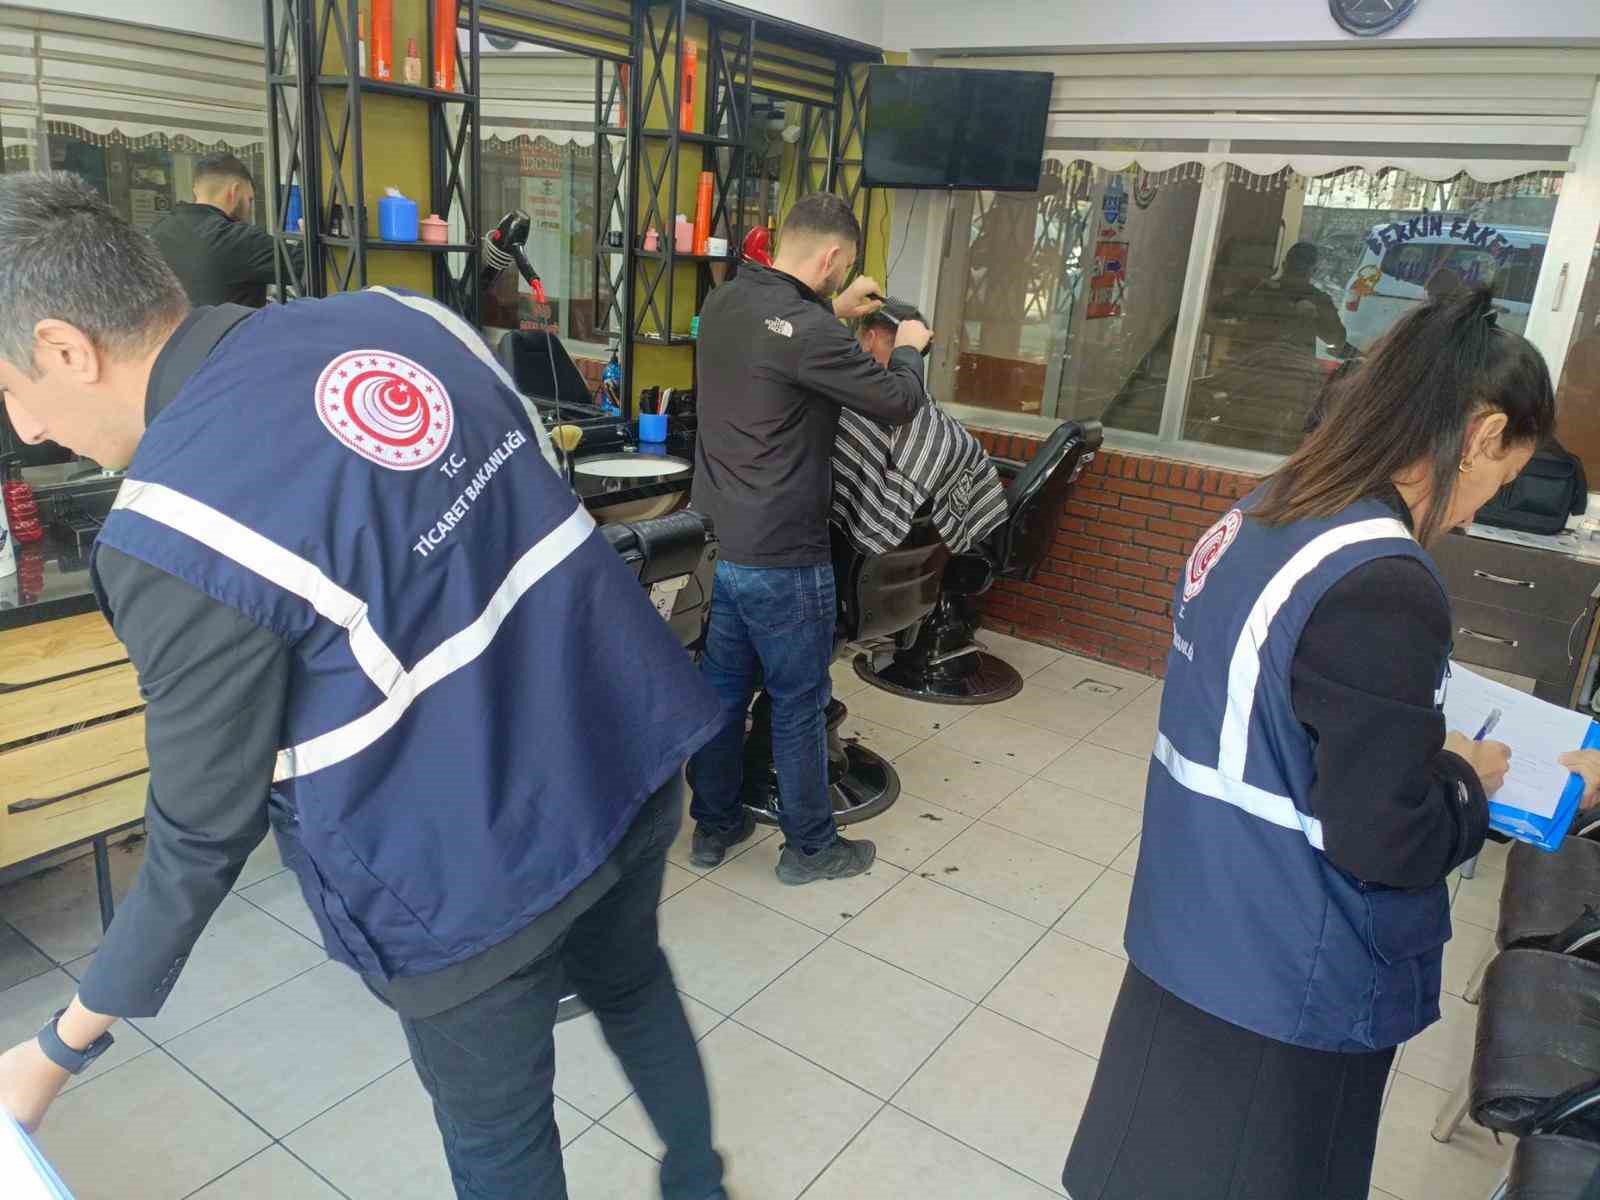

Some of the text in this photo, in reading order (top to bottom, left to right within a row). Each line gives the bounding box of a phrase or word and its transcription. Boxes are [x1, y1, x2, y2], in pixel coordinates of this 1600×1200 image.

[413, 428, 527, 557] TİCARET BAKANLIĞI
[439, 452, 467, 479] T.C.
